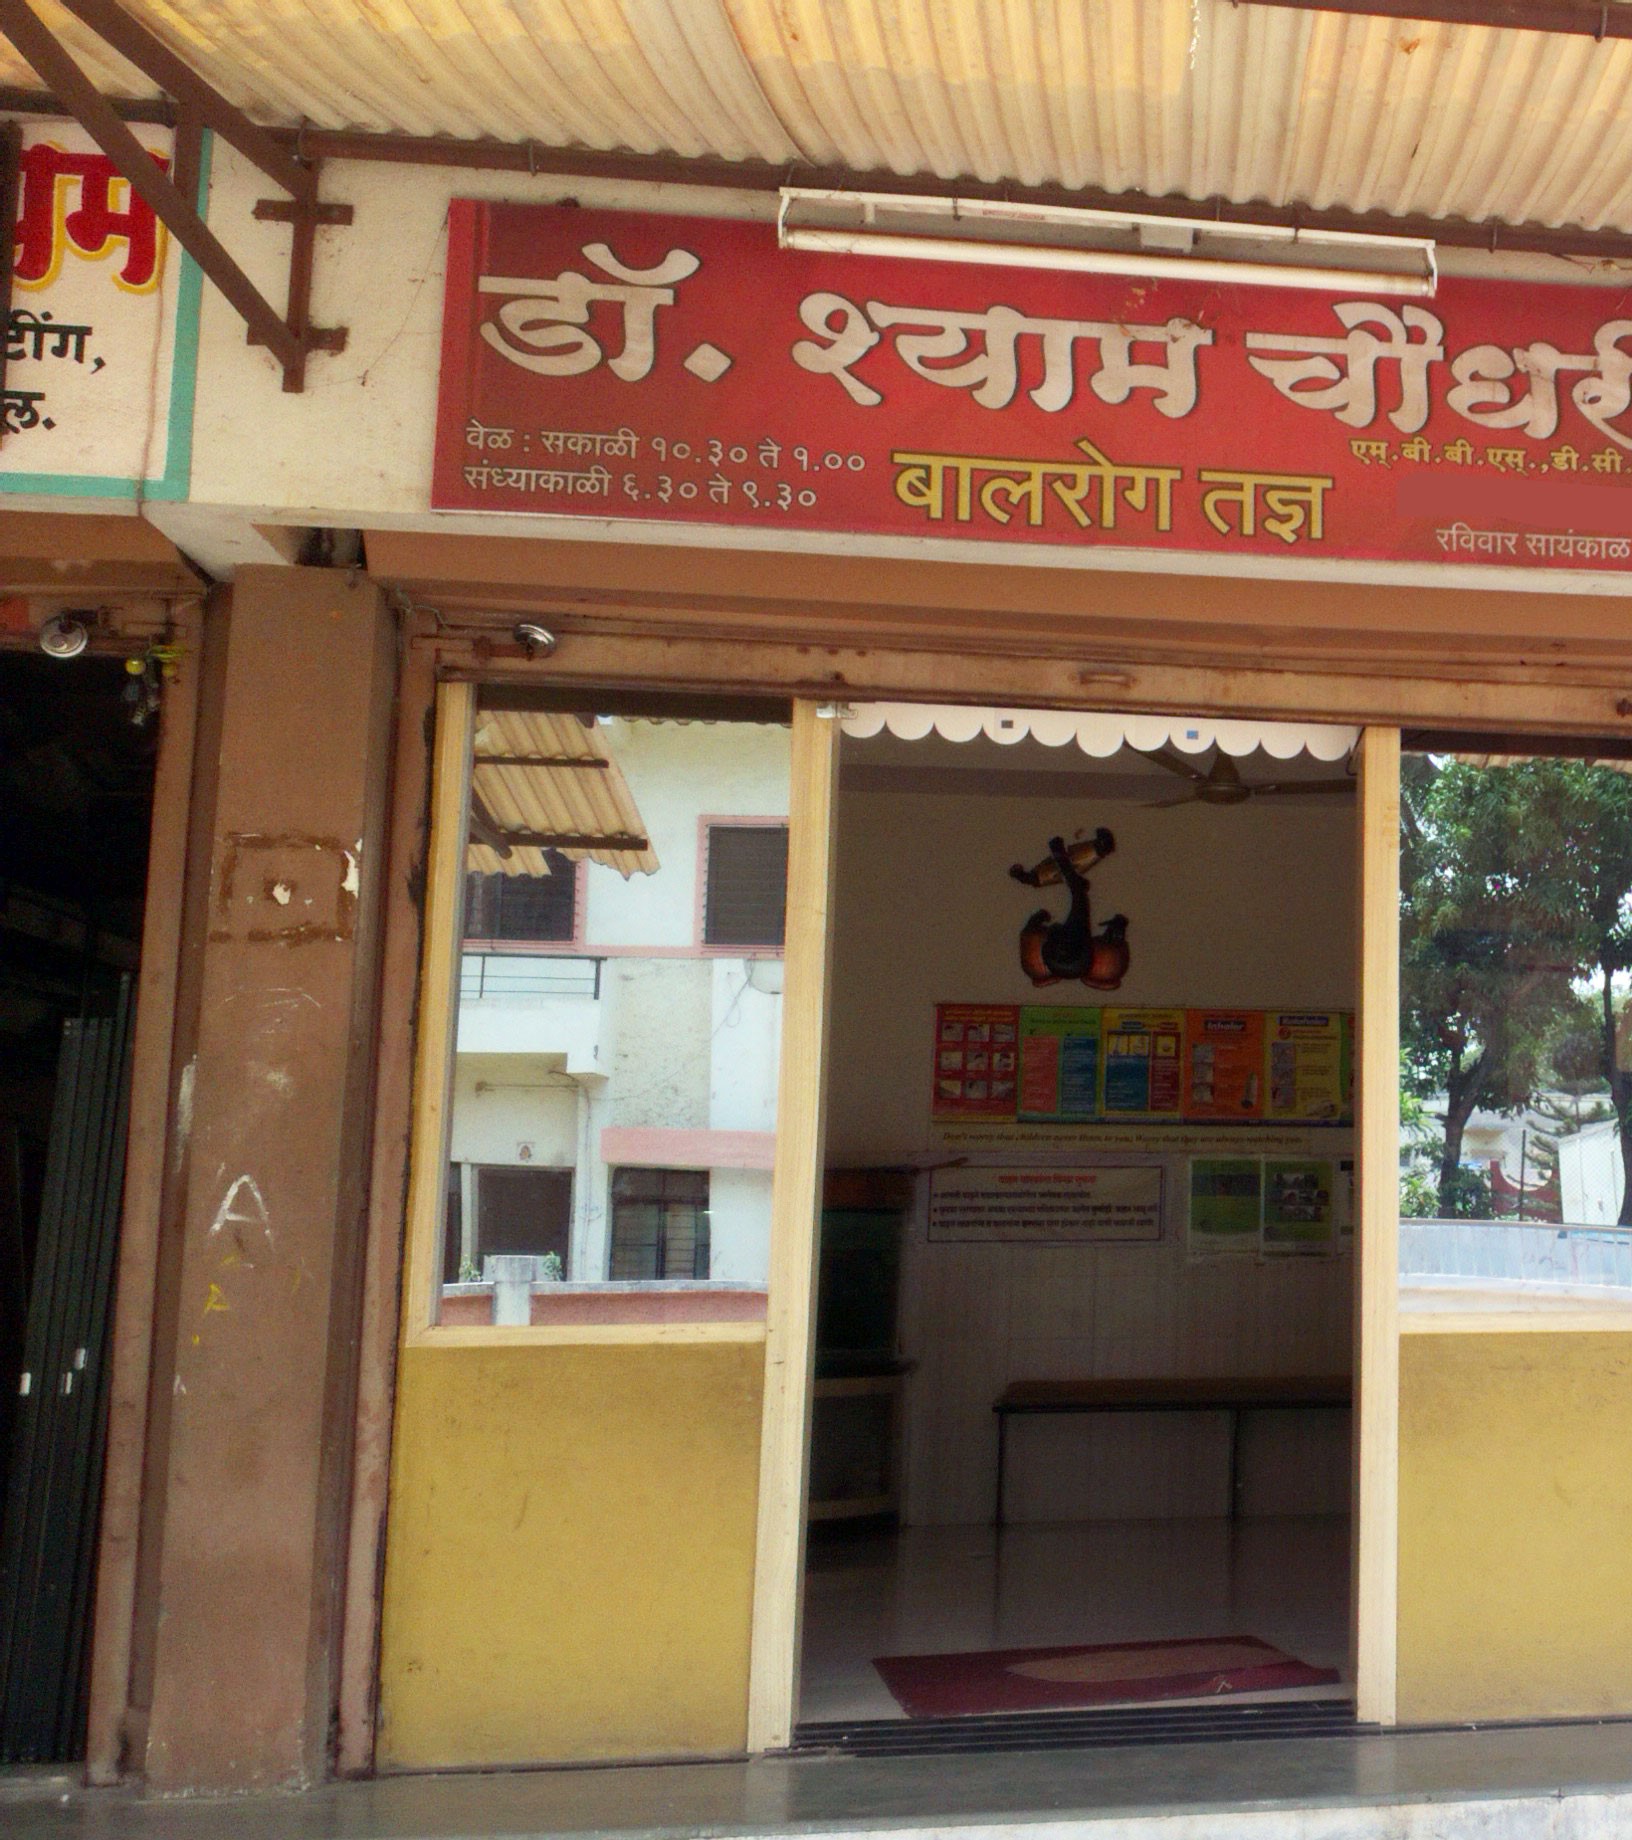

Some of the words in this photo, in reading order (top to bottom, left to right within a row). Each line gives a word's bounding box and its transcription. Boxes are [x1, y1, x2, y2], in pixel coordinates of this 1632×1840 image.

[477, 242, 733, 382] डॉ.
[790, 290, 1214, 419] श्याम
[540, 427, 641, 460] सकाळी
[651, 436, 749, 468] १०.३०
[757, 437, 783, 469] ते
[793, 446, 867, 472] १.००
[463, 458, 613, 497] संध्याकाळी
[622, 472, 699, 506] ६.३०
[707, 472, 733, 505] ते
[741, 480, 818, 511] ९.३०
[889, 435, 1183, 533] बालरोग
[1197, 468, 1335, 545] तज्ञ
[1436, 522, 1520, 556] रविवार
[1525, 528, 1631, 560] सायंकाळ
